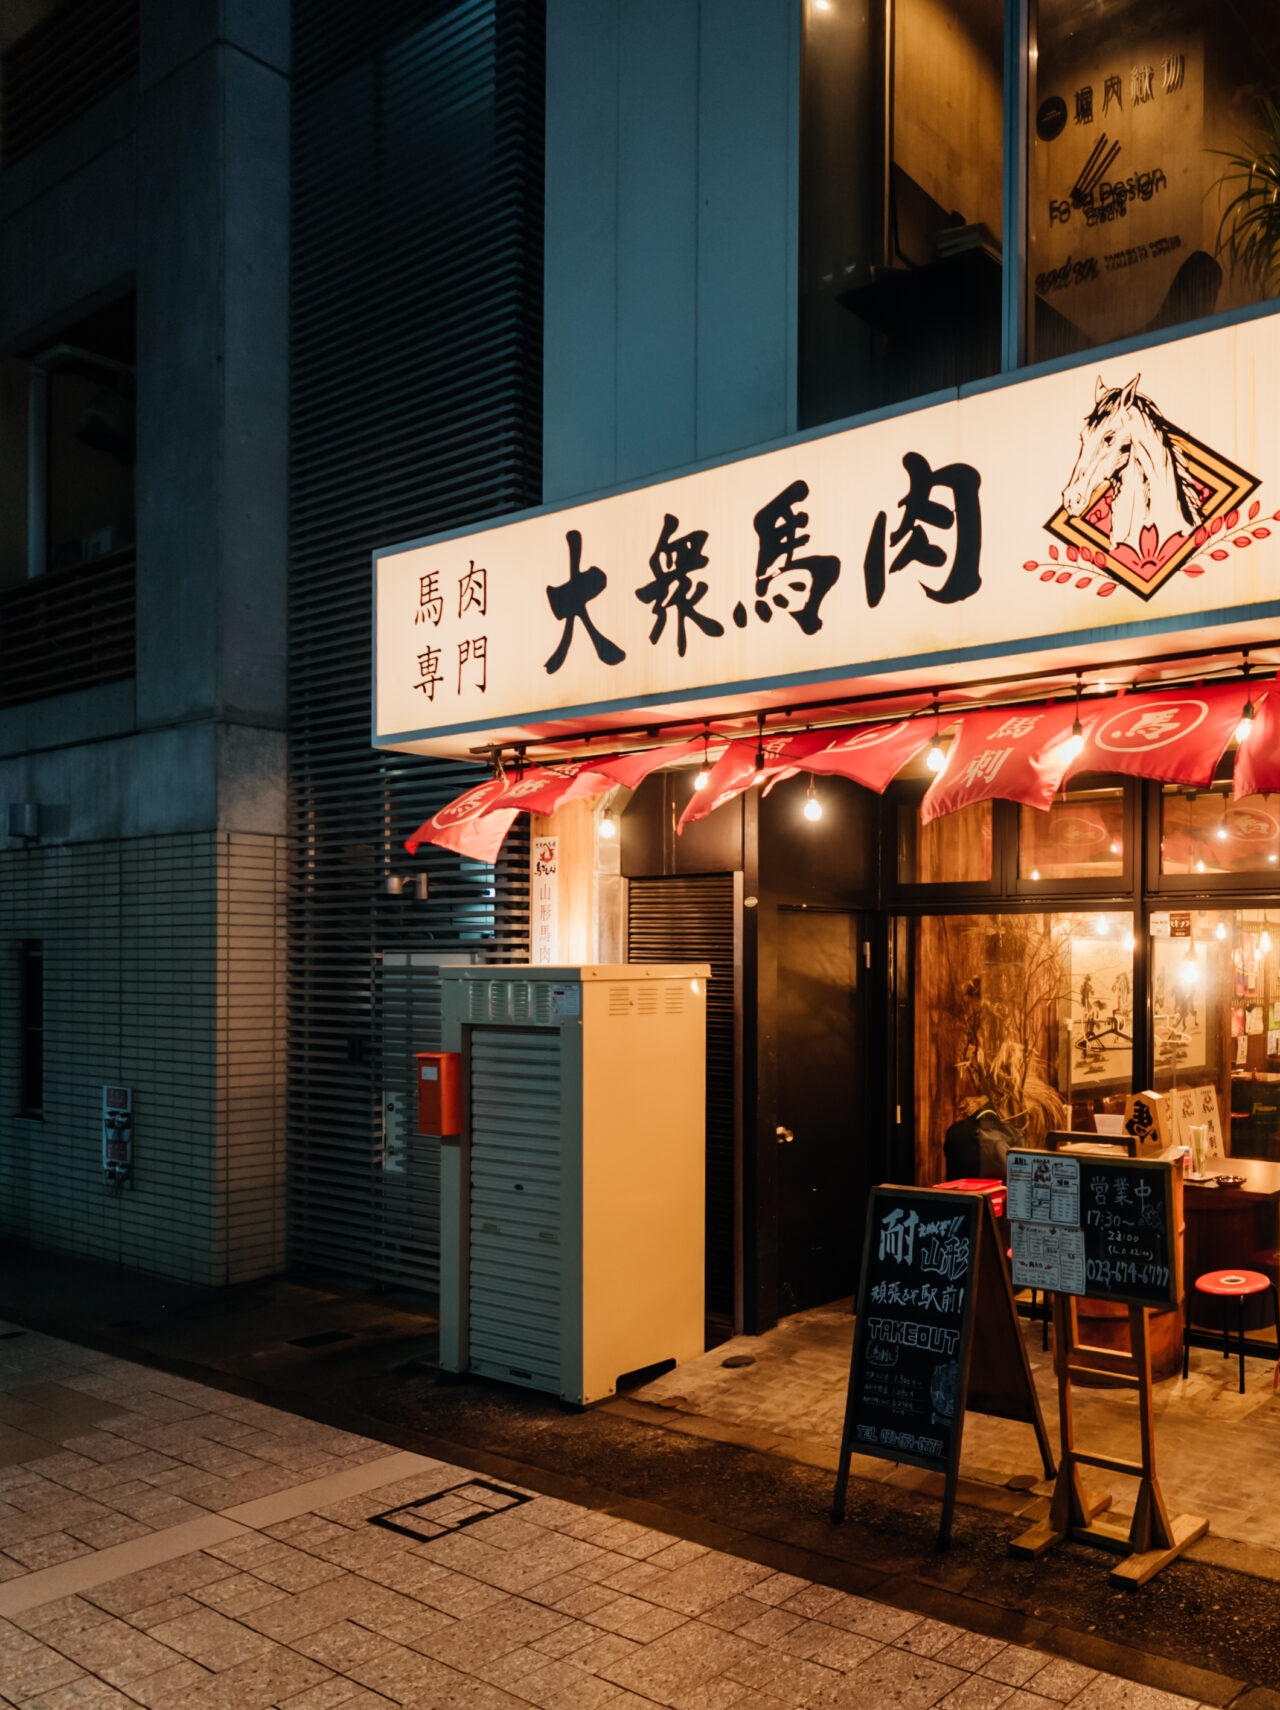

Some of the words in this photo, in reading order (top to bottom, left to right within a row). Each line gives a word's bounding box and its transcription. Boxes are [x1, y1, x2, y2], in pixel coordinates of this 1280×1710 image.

[544, 450, 983, 676] 大衆馬肉
[413, 559, 489, 628] 馬肉
[412, 635, 489, 704] 専門
[960, 714, 1046, 788] 馬刺
[1111, 707, 1180, 741] 馬
[539, 884, 552, 963] 山形馬肉
[1089, 1175, 1152, 1217] 営業中
[920, 1236, 969, 1281] 山形
[1086, 1258, 1170, 1287] 023-674-6777
[867, 1316, 960, 1355] TAKEOUT
